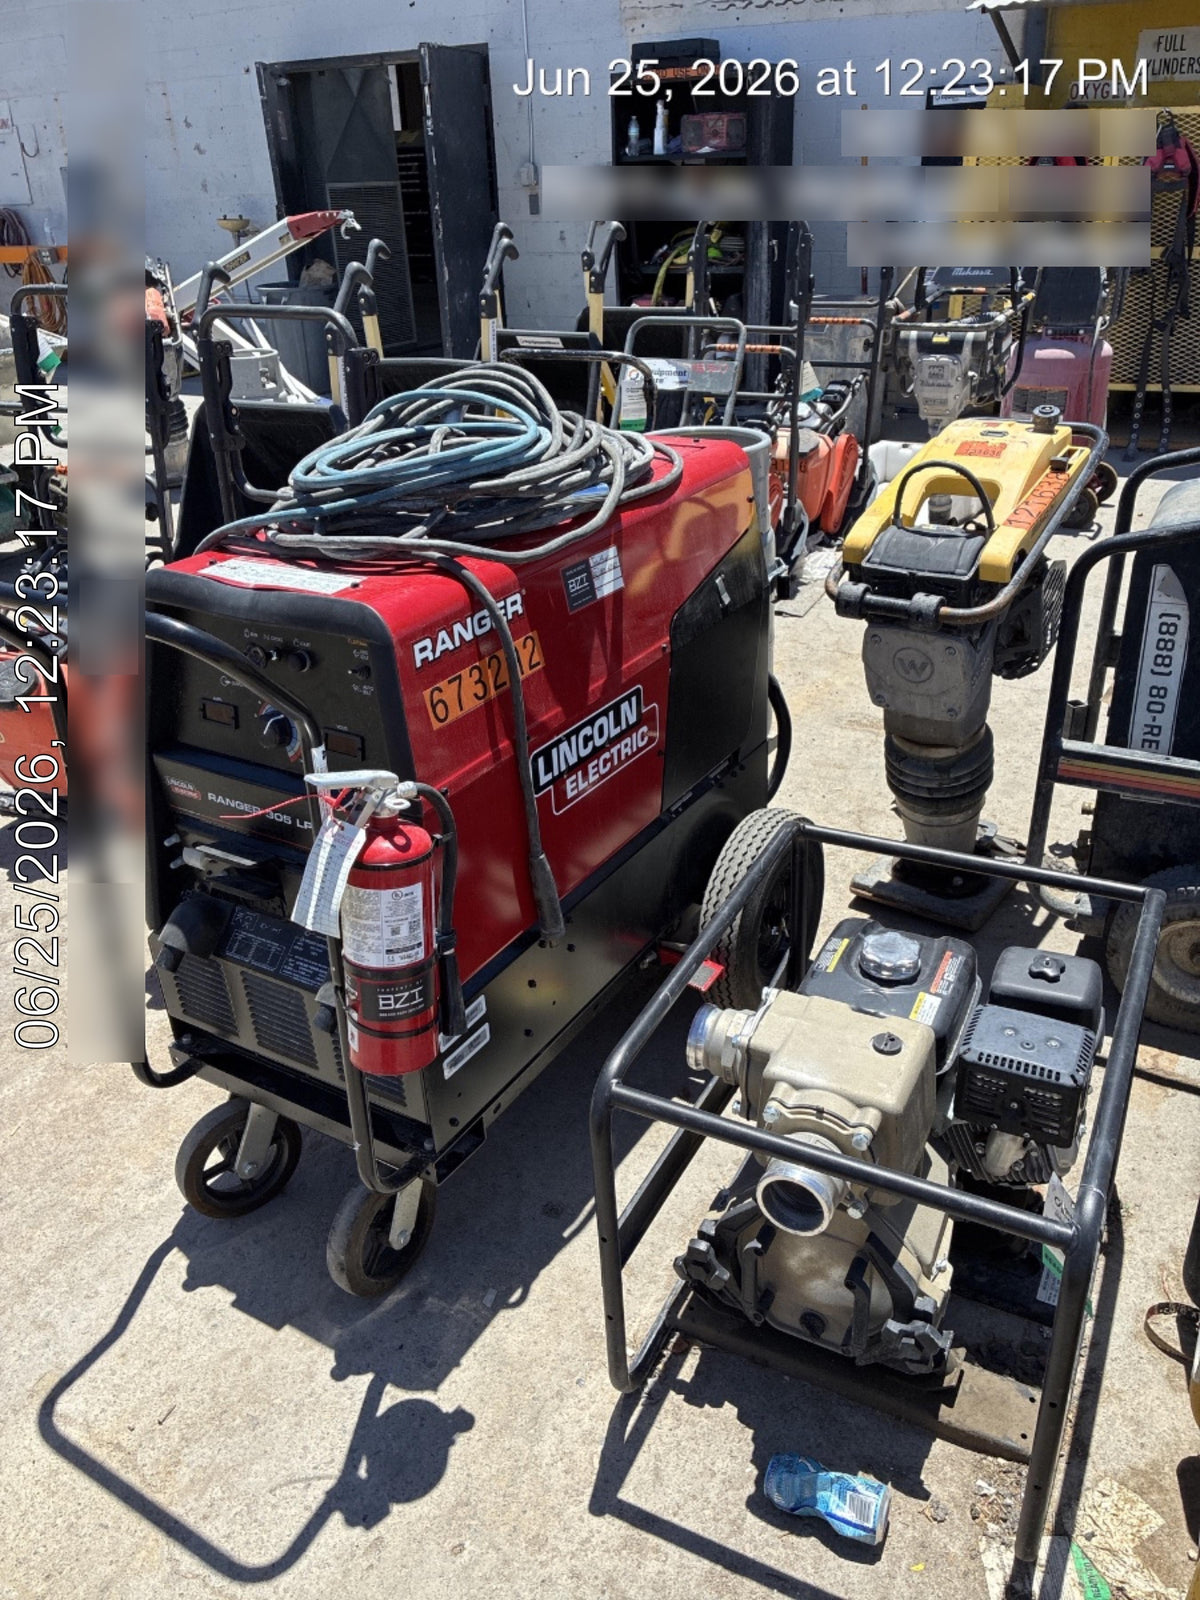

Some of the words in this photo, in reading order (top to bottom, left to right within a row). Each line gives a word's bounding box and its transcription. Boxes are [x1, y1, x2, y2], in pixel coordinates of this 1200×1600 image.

[1156, 34, 1187, 53] FULL
[1150, 612, 1182, 677] (888)
[538, 695, 638, 787] LINCOLN
[565, 725, 650, 800] ELECTRIC
[207, 792, 262, 814] RANGER
[264, 810, 293, 825] 305
[378, 986, 424, 1010] BZI
